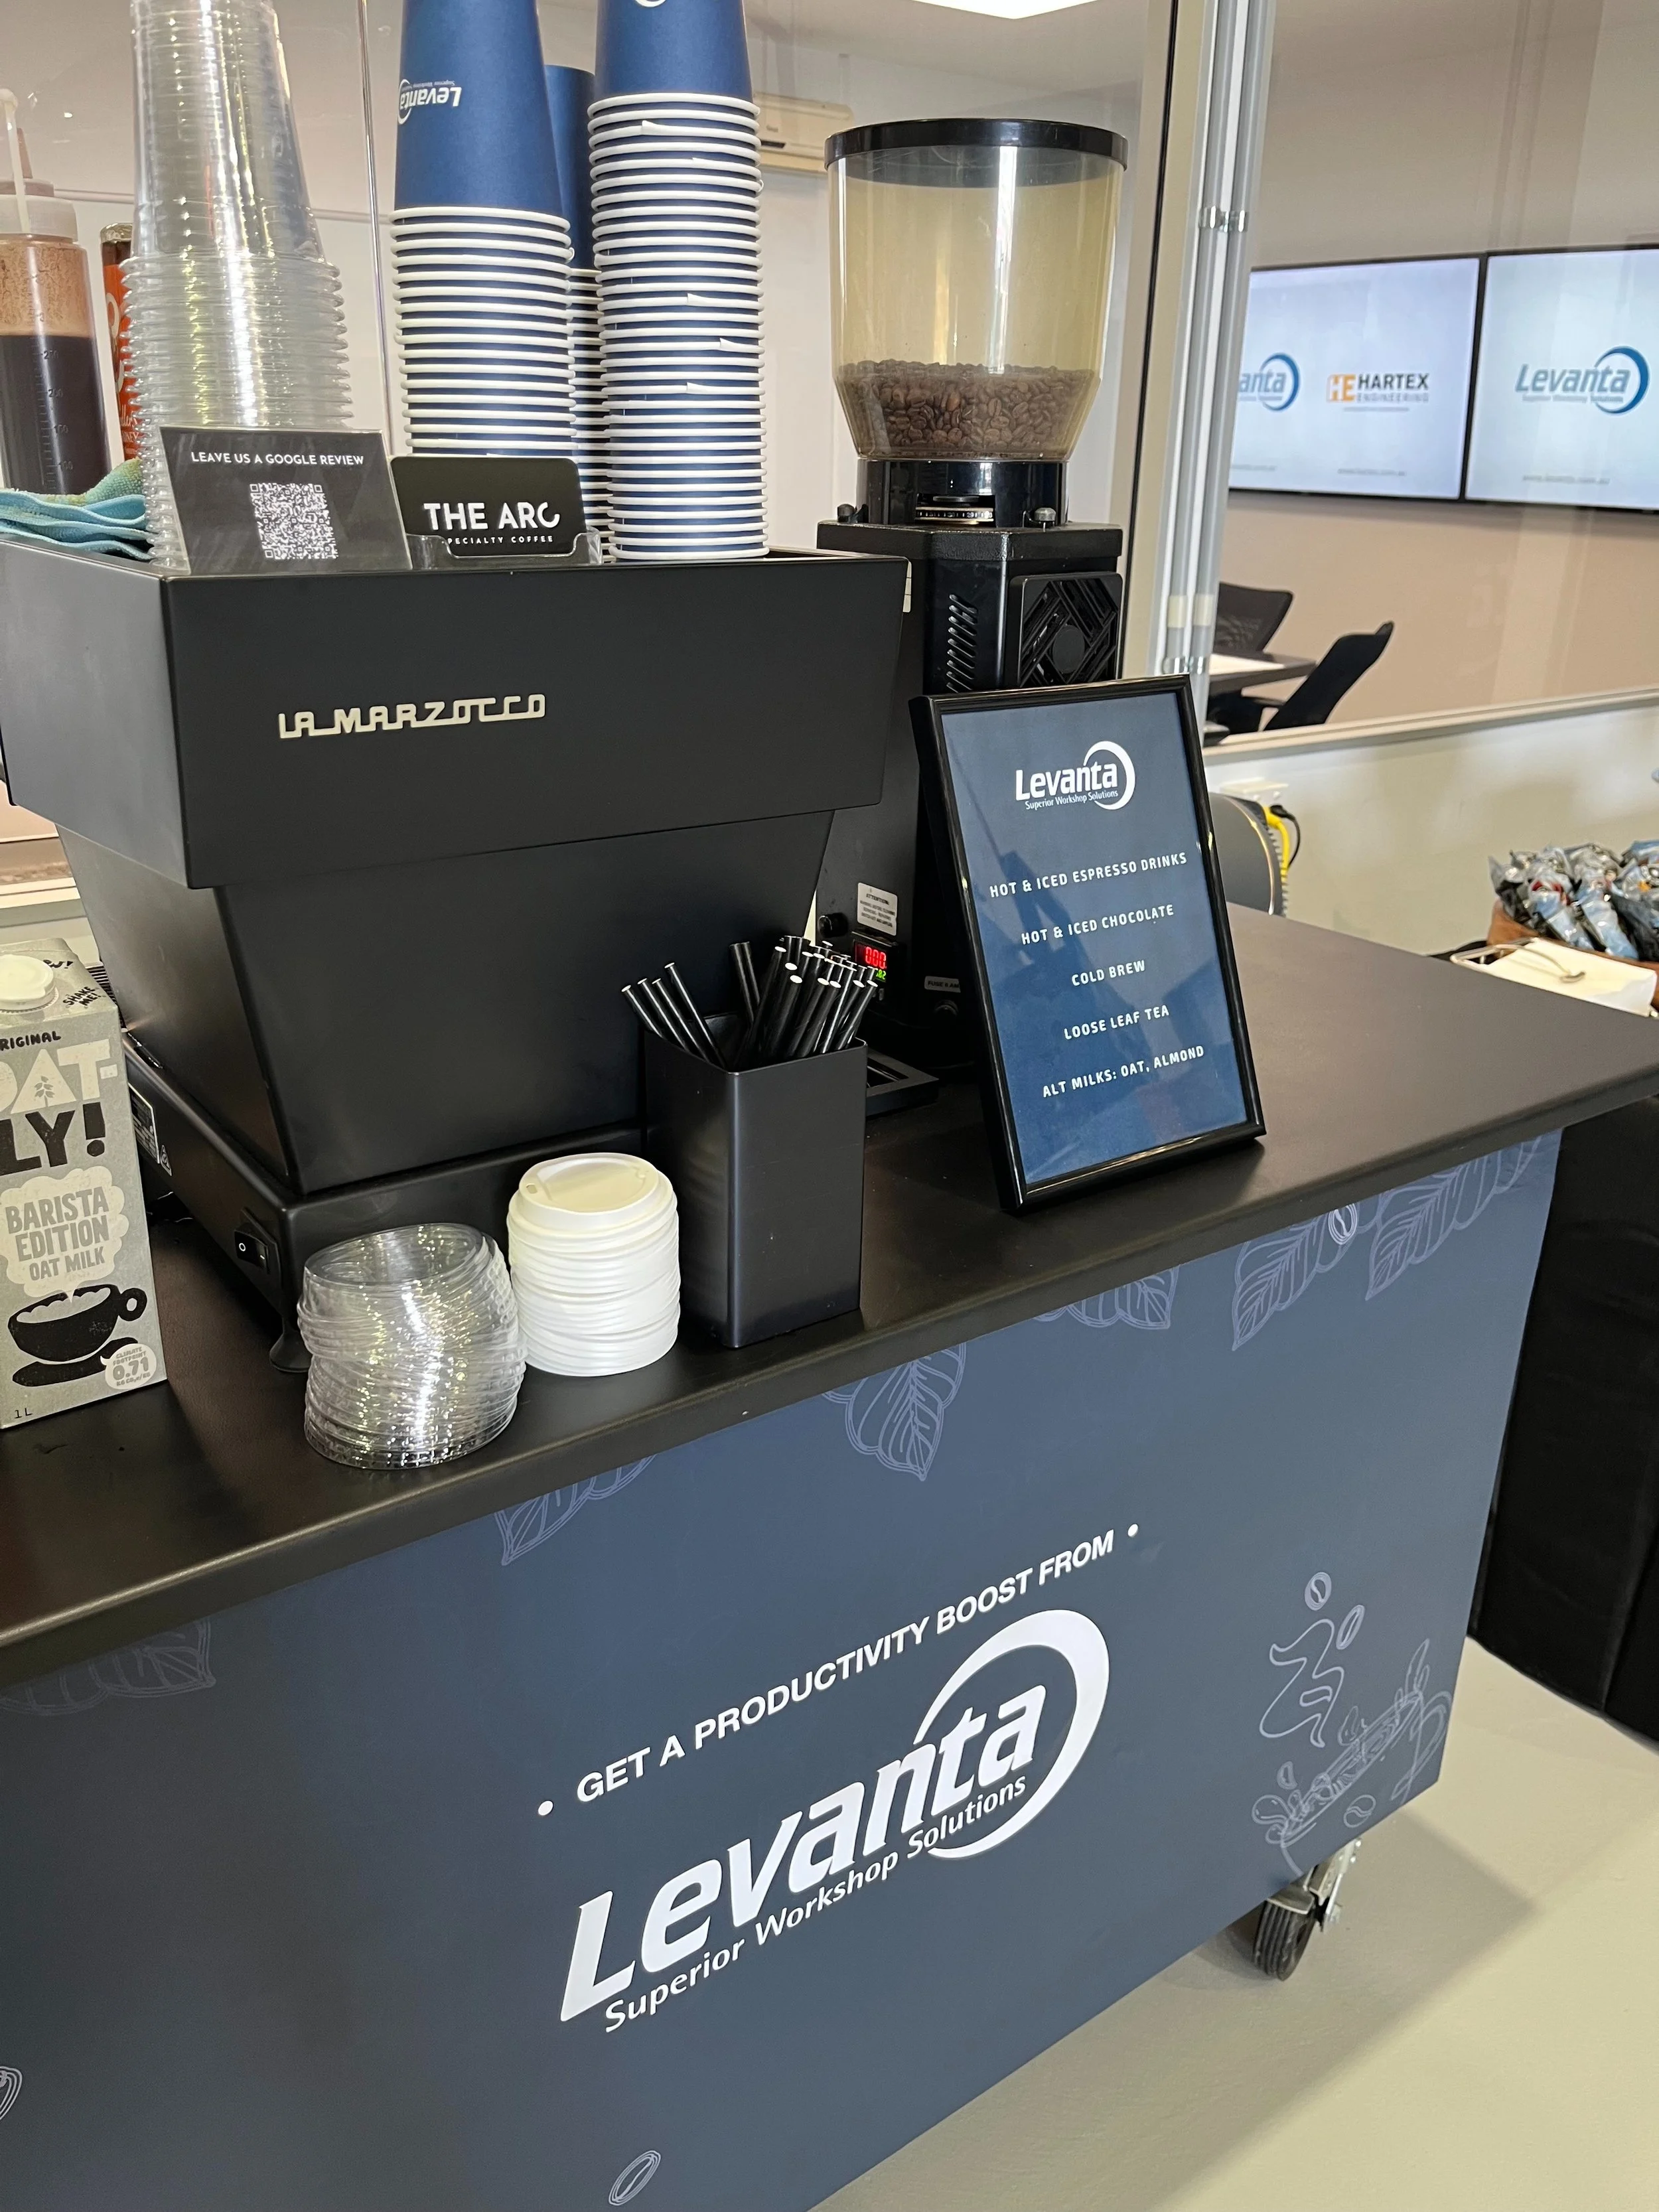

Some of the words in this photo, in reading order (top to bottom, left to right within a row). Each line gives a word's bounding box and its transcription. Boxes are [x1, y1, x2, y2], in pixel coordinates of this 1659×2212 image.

[399, 87, 462, 110] Levanta
[1238, 370, 1287, 394] anta
[1358, 373, 1430, 390] HARTEX
[1515, 364, 1631, 394] Levanta
[191, 451, 232, 463] LEAVE
[234, 453, 251, 464] US
[254, 454, 263, 464] A
[265, 454, 317, 465] GOOGLE
[320, 455, 364, 465] REVIEW
[423, 502, 488, 530] THE
[498, 502, 561, 529] ARC
[447, 536, 504, 545] PECIALTY
[278, 711, 315, 739] LA
[1016, 761, 1118, 801] Levanta
[1025, 798, 1054, 810] Superior
[1056, 793, 1088, 805] Workshop
[1088, 789, 1119, 801] Solutions
[989, 881, 1017, 898] HOT
[1023, 879, 1033, 892] &
[1037, 873, 1068, 889] ICED
[1072, 861, 1137, 883] ESPRESSO
[1141, 852, 1187, 871] DRINKS
[1021, 929, 1048, 945] HOT
[1053, 926, 1063, 938] &
[1068, 919, 1098, 936] ICED
[1102, 904, 1175, 929] CHOCOLATE
[1071, 969, 1105, 986] COLD
[1109, 960, 1145, 979] BREW
[63, 986, 96, 1005] SHAKE
[79, 992, 102, 1006] ME!
[1064, 1019, 1107, 1040] LOOSE
[1110, 1011, 1140, 1029] LEAF
[1145, 1005, 1170, 1021] TEA
[0, 1031, 62, 1051] RIGINAL
[1043, 1080, 1066, 1098] ALT
[1071, 1069, 1117, 1090] MILKS:
[1120, 1061, 1150, 1078] OAT,
[1154, 1045, 1205, 1069] ALMOND
[0, 1102, 106, 1177] LY!
[5, 1186, 109, 1234] BARISTA
[15, 1215, 109, 1262] EDITION
[29, 1258, 60, 1282] OAT
[66, 1246, 106, 1274] MILK
[113, 1357, 149, 1381] 0.71
[577, 1746, 651, 1803] GET
[660, 1734, 685, 1767] A
[695, 1615, 930, 1750] PRODUCTIVITY
[936, 1568, 1033, 1635] BOOST
[1039, 1528, 1114, 1585] FROM
[560, 1684, 1046, 2022] Levanta
[605, 1938, 745, 2033] Superior
[755, 1850, 899, 1946] Workshop
[907, 1775, 1027, 1859] Solutions
